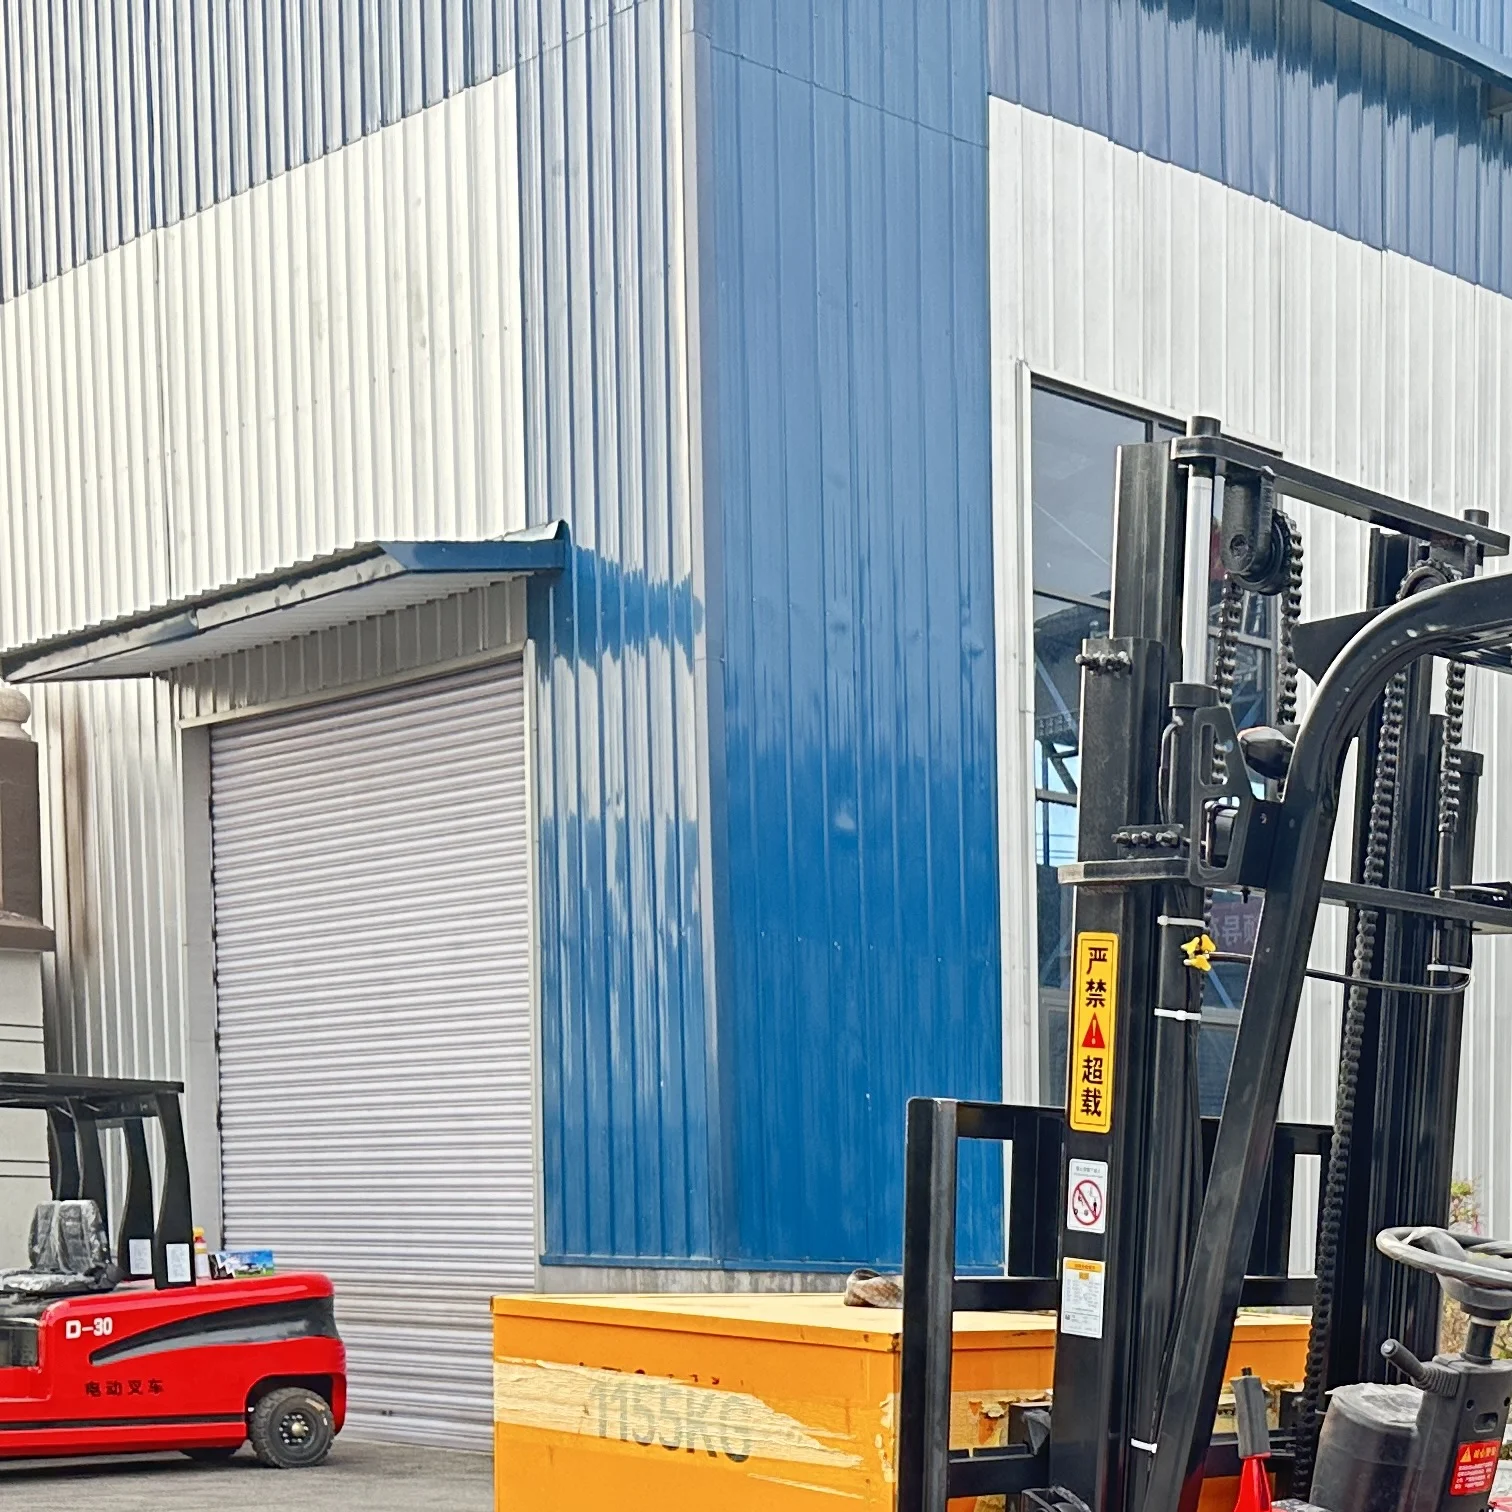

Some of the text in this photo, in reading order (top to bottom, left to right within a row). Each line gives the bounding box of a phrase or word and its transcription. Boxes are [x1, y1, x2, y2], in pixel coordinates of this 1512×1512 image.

[65, 1316, 113, 1339] D-30
[84, 1379, 164, 1397] 电动叉车
